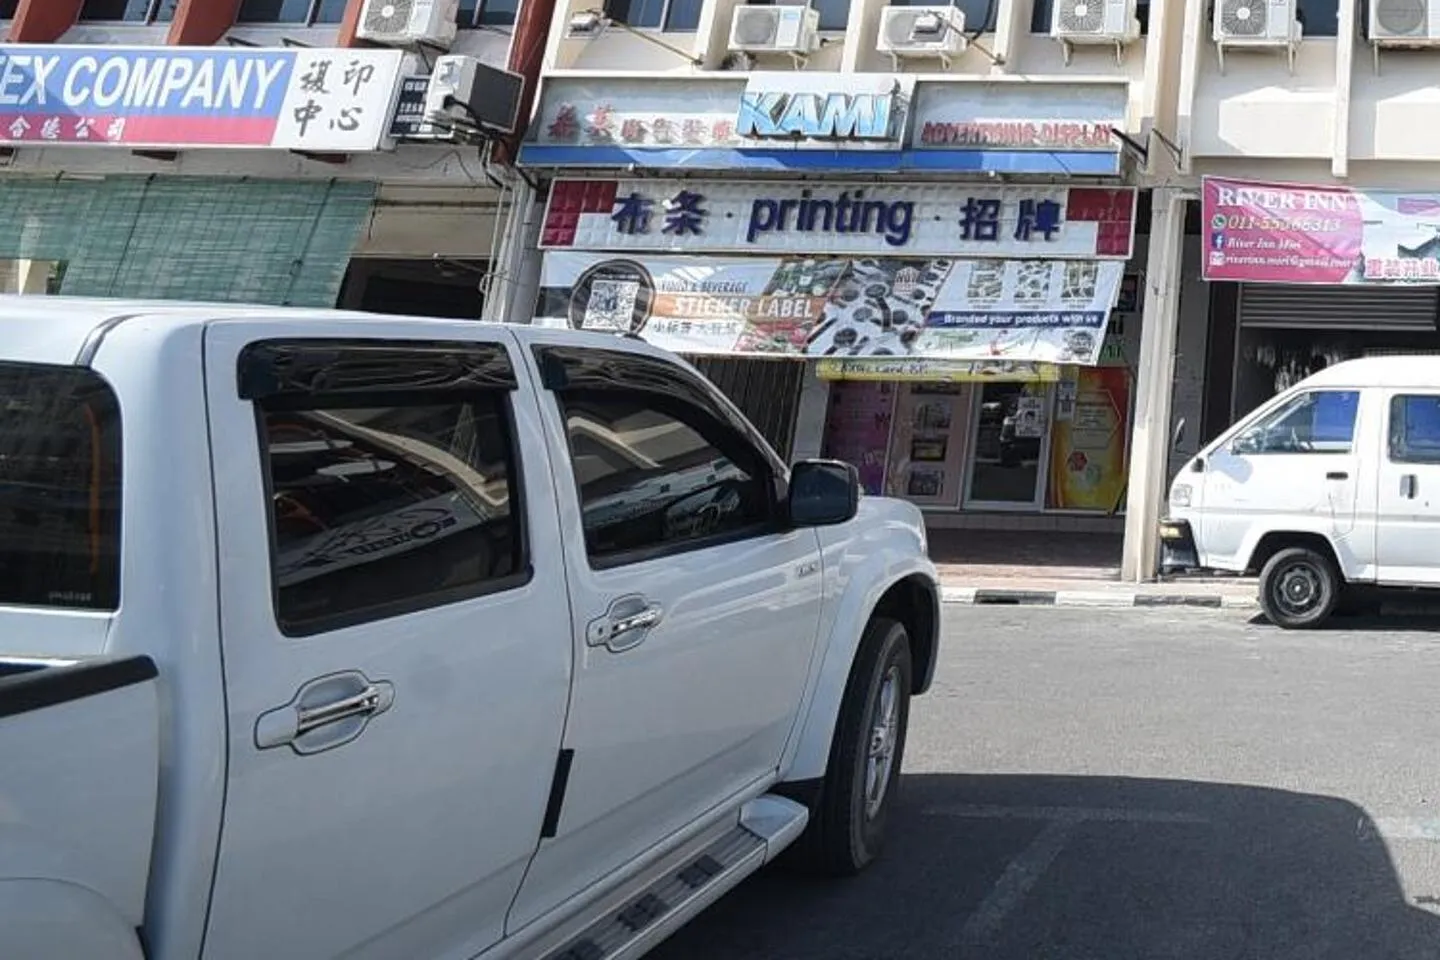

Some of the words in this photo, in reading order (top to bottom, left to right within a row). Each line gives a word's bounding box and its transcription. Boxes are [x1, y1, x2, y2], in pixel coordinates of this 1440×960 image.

[0, 54, 60, 104] EX
[63, 56, 292, 111] COMPANY
[611, 190, 708, 235] 布条
[746, 189, 916, 246] printing
[959, 196, 1064, 242] 招牌
[1216, 187, 1297, 209] RIVER
[1303, 192, 1347, 211] INN
[674, 296, 750, 316] STICKER
[757, 297, 814, 318] LABEL
[943, 313, 987, 324] Branded
[988, 315, 1012, 325] your
[1015, 313, 1060, 325] products
[1062, 313, 1083, 324] with
